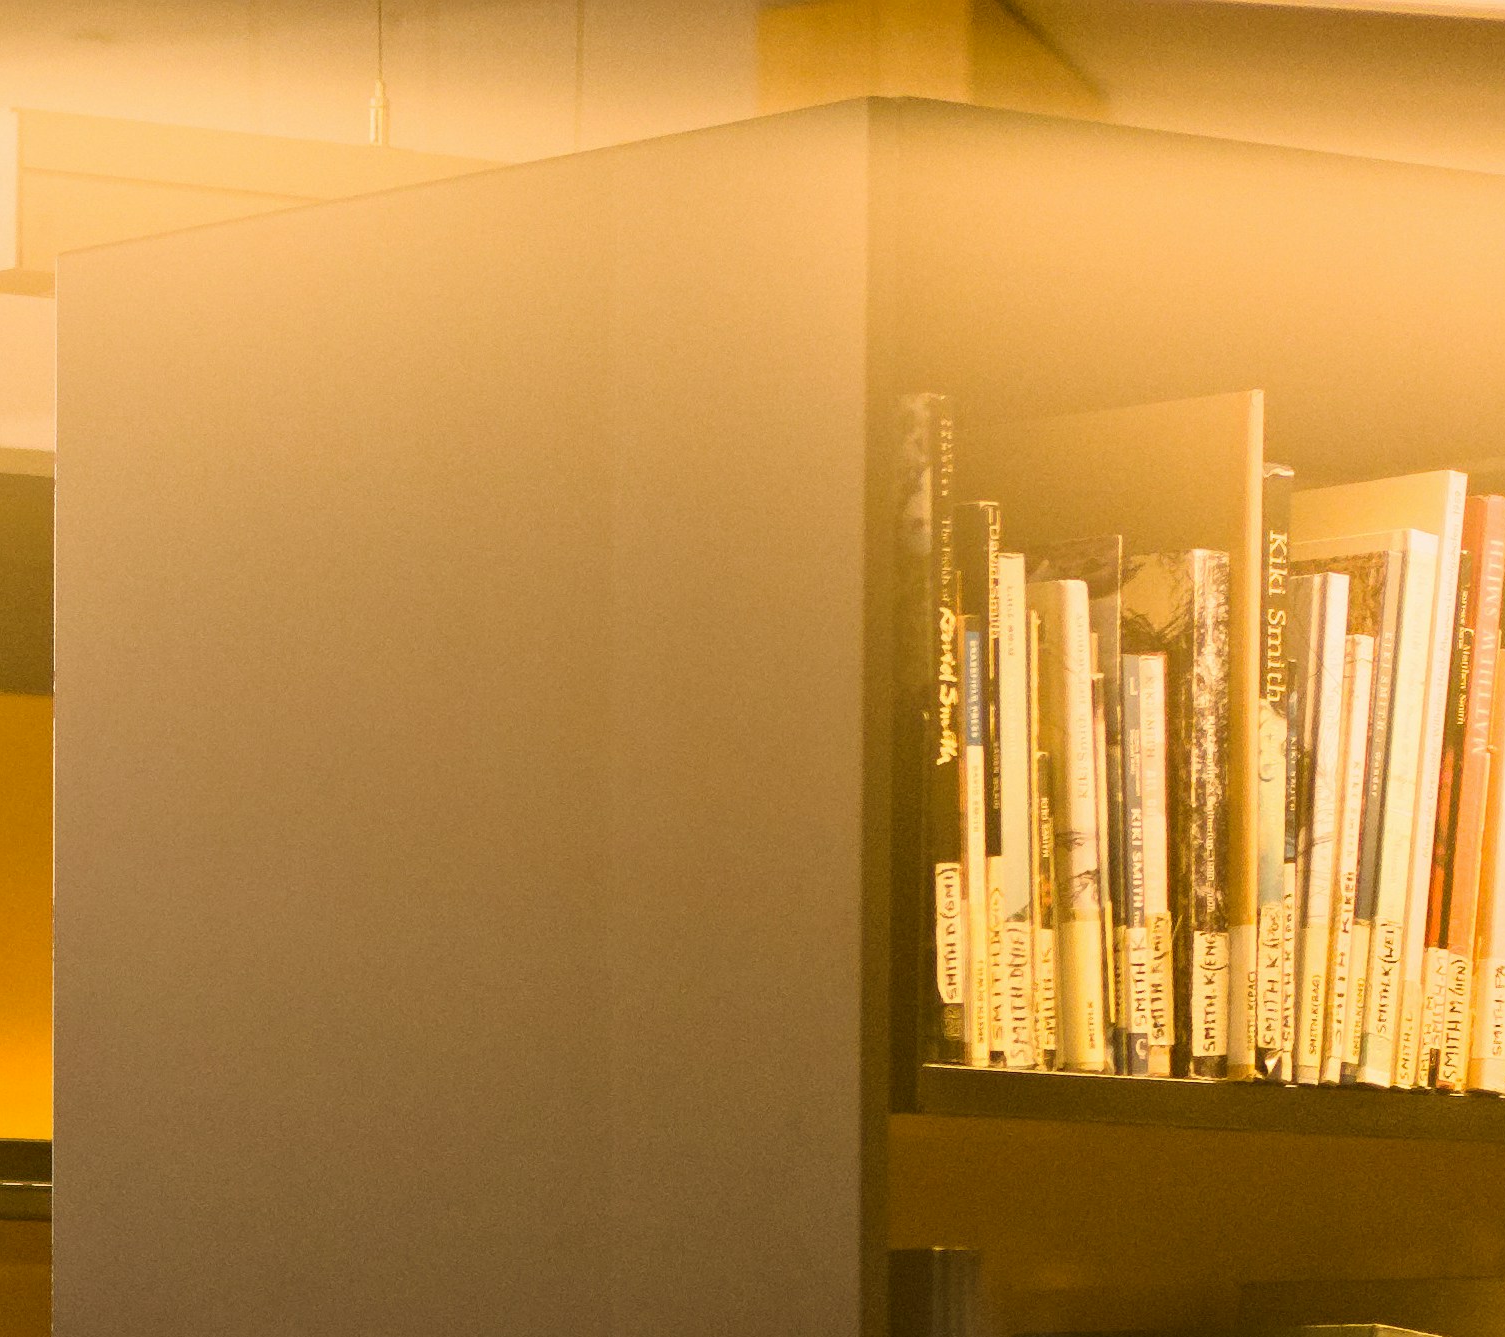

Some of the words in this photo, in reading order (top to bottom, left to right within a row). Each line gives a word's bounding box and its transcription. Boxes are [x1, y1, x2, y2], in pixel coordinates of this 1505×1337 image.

[1267, 530, 1286, 596] Kiki
[1266, 608, 1286, 702] Smith
[1471, 630, 1497, 755] MATTHEW
[1484, 540, 1504, 617] SMITH
[1131, 808, 1143, 846] KIKI
[1132, 850, 1143, 907] SMITH
